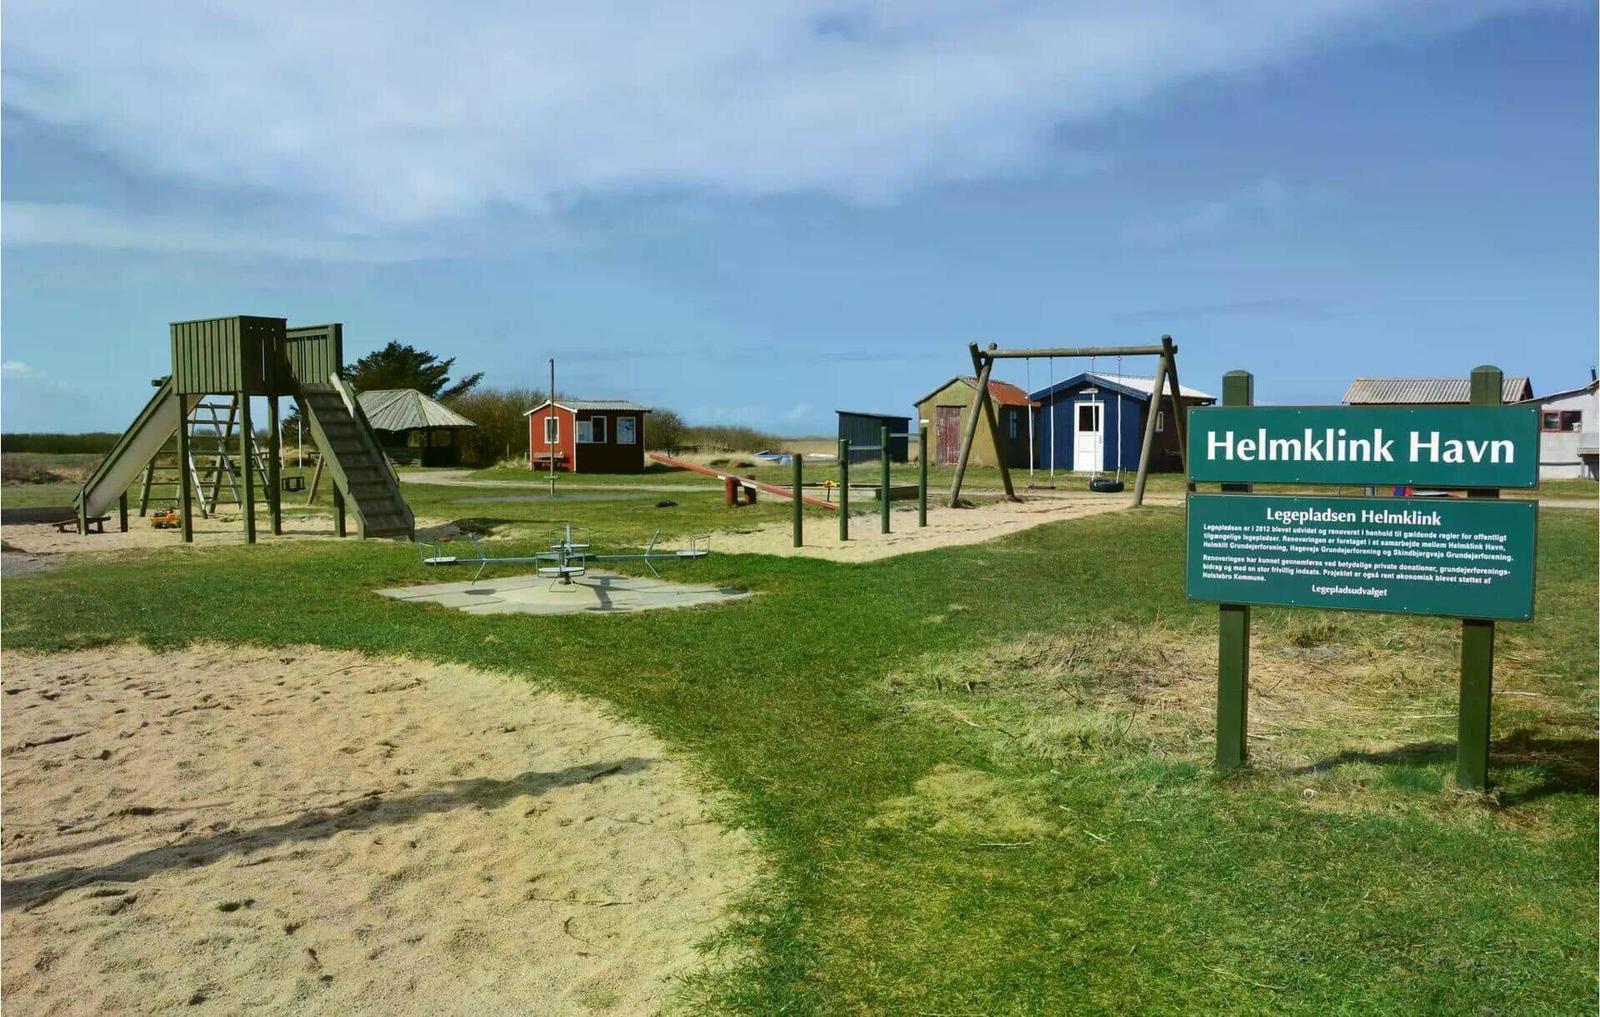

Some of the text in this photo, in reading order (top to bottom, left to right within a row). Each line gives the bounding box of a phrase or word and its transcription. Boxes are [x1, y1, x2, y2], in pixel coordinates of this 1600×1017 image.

[1207, 428, 1515, 463] Helmklink Havn
[1266, 507, 1442, 526] Legepladsen Helmklink
[1203, 523, 1242, 532] Legepladsen
[1366, 529, 1393, 537] henhold
[1403, 531, 1437, 539] gældende
[1438, 532, 1460, 540] regler
[1473, 533, 1507, 542] offentligt
[1203, 532, 1241, 541] tilgængelige
[1243, 534, 1281, 542] legepladser.
[1282, 535, 1326, 544] Renoveringen
[1336, 537, 1367, 546] foretaget
[1380, 539, 1420, 548] samarbejde
[1421, 541, 1447, 549] mellem
[1448, 542, 1483, 550] Helmklink
[1485, 543, 1506, 552] Havn,
[1229, 542, 1289, 552] Grundejerforening,
[1290, 545, 1319, 554] Hagevejs
[1320, 546, 1381, 556] Grundejerforening
[1393, 549, 1444, 559] Skindbjergvejs
[1446, 551, 1514, 562] Grundejerforening.
[1202, 554, 1245, 563] Renoveringen
[1337, 561, 1372, 570] betydelige
[1373, 563, 1397, 571] private
[1398, 563, 1438, 573] donationer,
[1439, 565, 1511, 577] grundejerforenings-
[1202, 563, 1222, 572] bidrag
[1257, 565, 1270, 573] stor
[1271, 566, 1294, 575] frivillig
[1322, 569, 1353, 577] Projektet
[1362, 571, 1379, 579] også
[1202, 572, 1267, 581] Holstebro Kommune.
[1311, 584, 1388, 598] Legepladsudvalget
